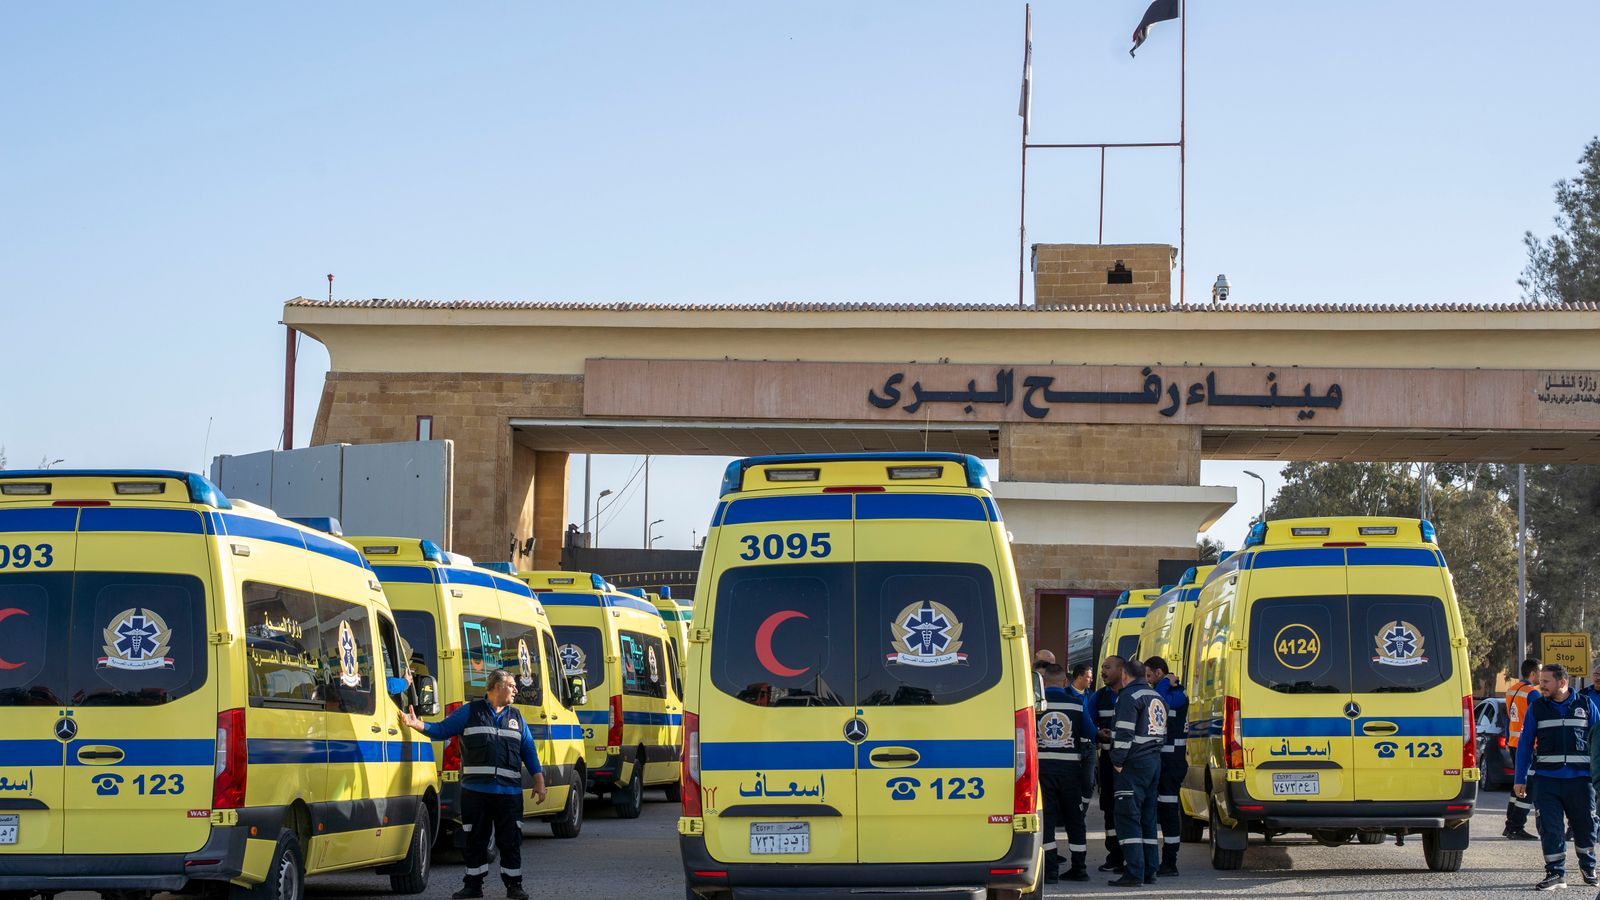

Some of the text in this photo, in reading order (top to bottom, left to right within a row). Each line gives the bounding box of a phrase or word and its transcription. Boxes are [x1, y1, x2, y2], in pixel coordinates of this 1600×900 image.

[1022, 366, 1180, 419] رفح
[1545, 375, 1597, 392] وزارة النقل
[1187, 370, 1342, 421] ميناء
[740, 532, 832, 561] 3095
[1278, 638, 1318, 655] 4124
[1556, 653, 1575, 662] Stop
[1562, 664, 1584, 673] heck
[1404, 742, 1443, 758] 123
[132, 773, 185, 795] 123
[739, 771, 825, 803] إسعاف
[929, 777, 985, 800] 123
